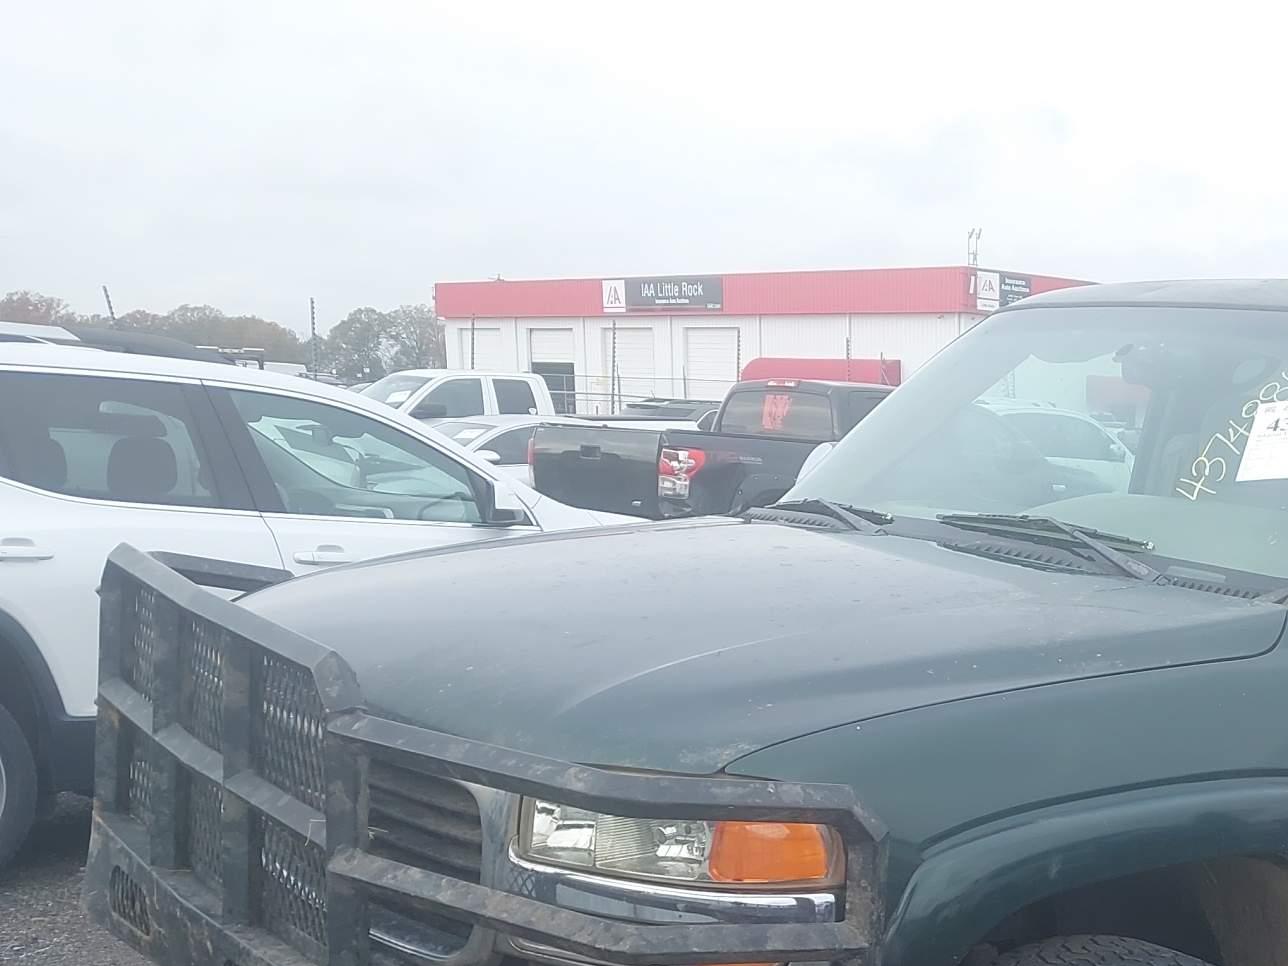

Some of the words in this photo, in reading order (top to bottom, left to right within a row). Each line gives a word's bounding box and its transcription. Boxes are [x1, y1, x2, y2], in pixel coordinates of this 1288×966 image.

[641, 283, 655, 297] IAA
[657, 282, 679, 297] Little
[681, 281, 704, 297] Rock
